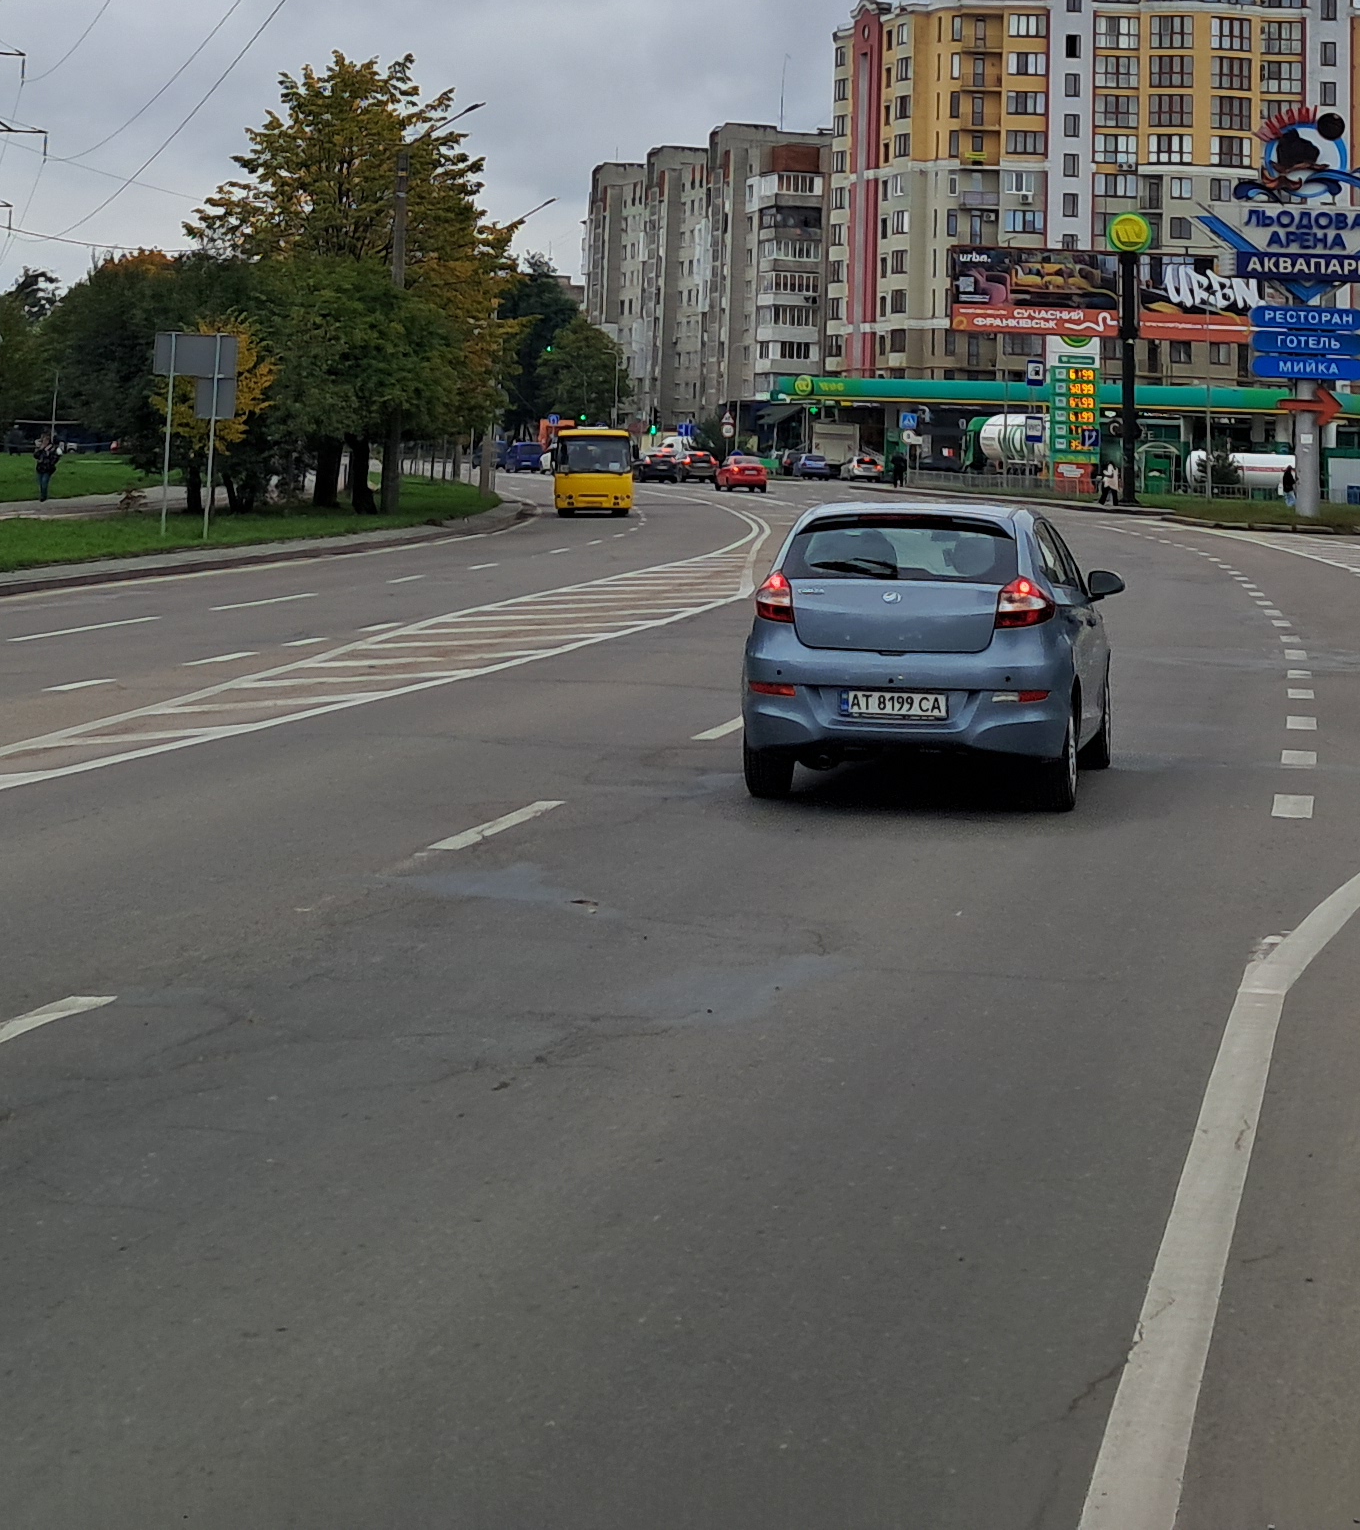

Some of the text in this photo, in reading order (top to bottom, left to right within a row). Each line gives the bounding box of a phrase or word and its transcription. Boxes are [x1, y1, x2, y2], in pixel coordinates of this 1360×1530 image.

[1266, 230, 1347, 251] АРЕНА
[1013, 308, 1084, 320] СУЧАСНИЙ
[1264, 310, 1353, 325] РЕСТОРАН
[973, 317, 1057, 330] ФРАНКІВСЬК
[1277, 336, 1341, 349] ГОТЕЛЬ
[1279, 360, 1339, 375] МИЙКА
[850, 693, 941, 713] AT 8199 CA
